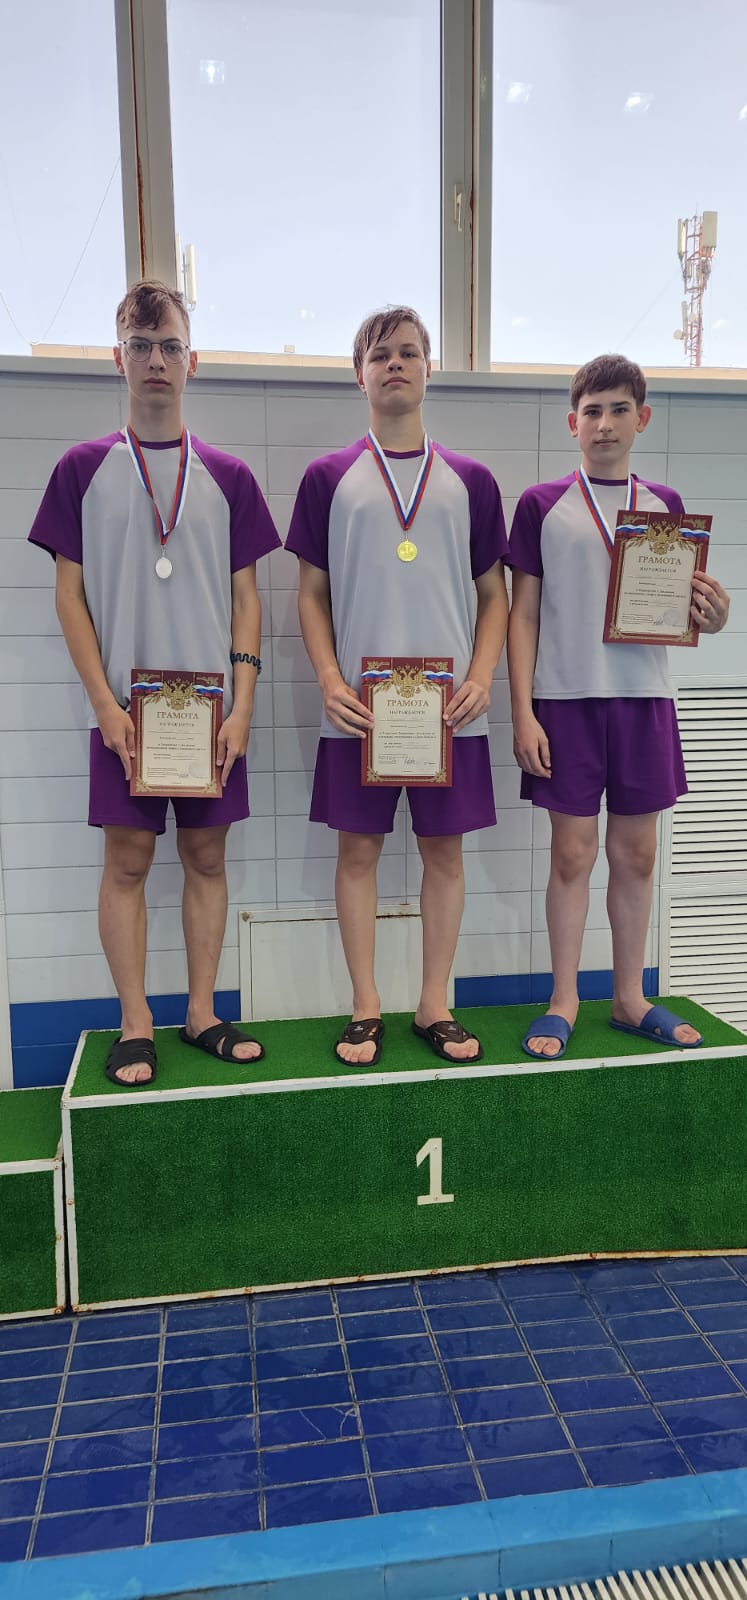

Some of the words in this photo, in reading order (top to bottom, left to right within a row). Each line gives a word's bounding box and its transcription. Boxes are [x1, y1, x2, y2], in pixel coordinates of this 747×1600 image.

[637, 555, 682, 566] ГРАМОТА
[386, 699, 429, 708] ГРАМОТА
[156, 711, 199, 720] ГРАМОТА
[416, 1137, 455, 1205] 1
